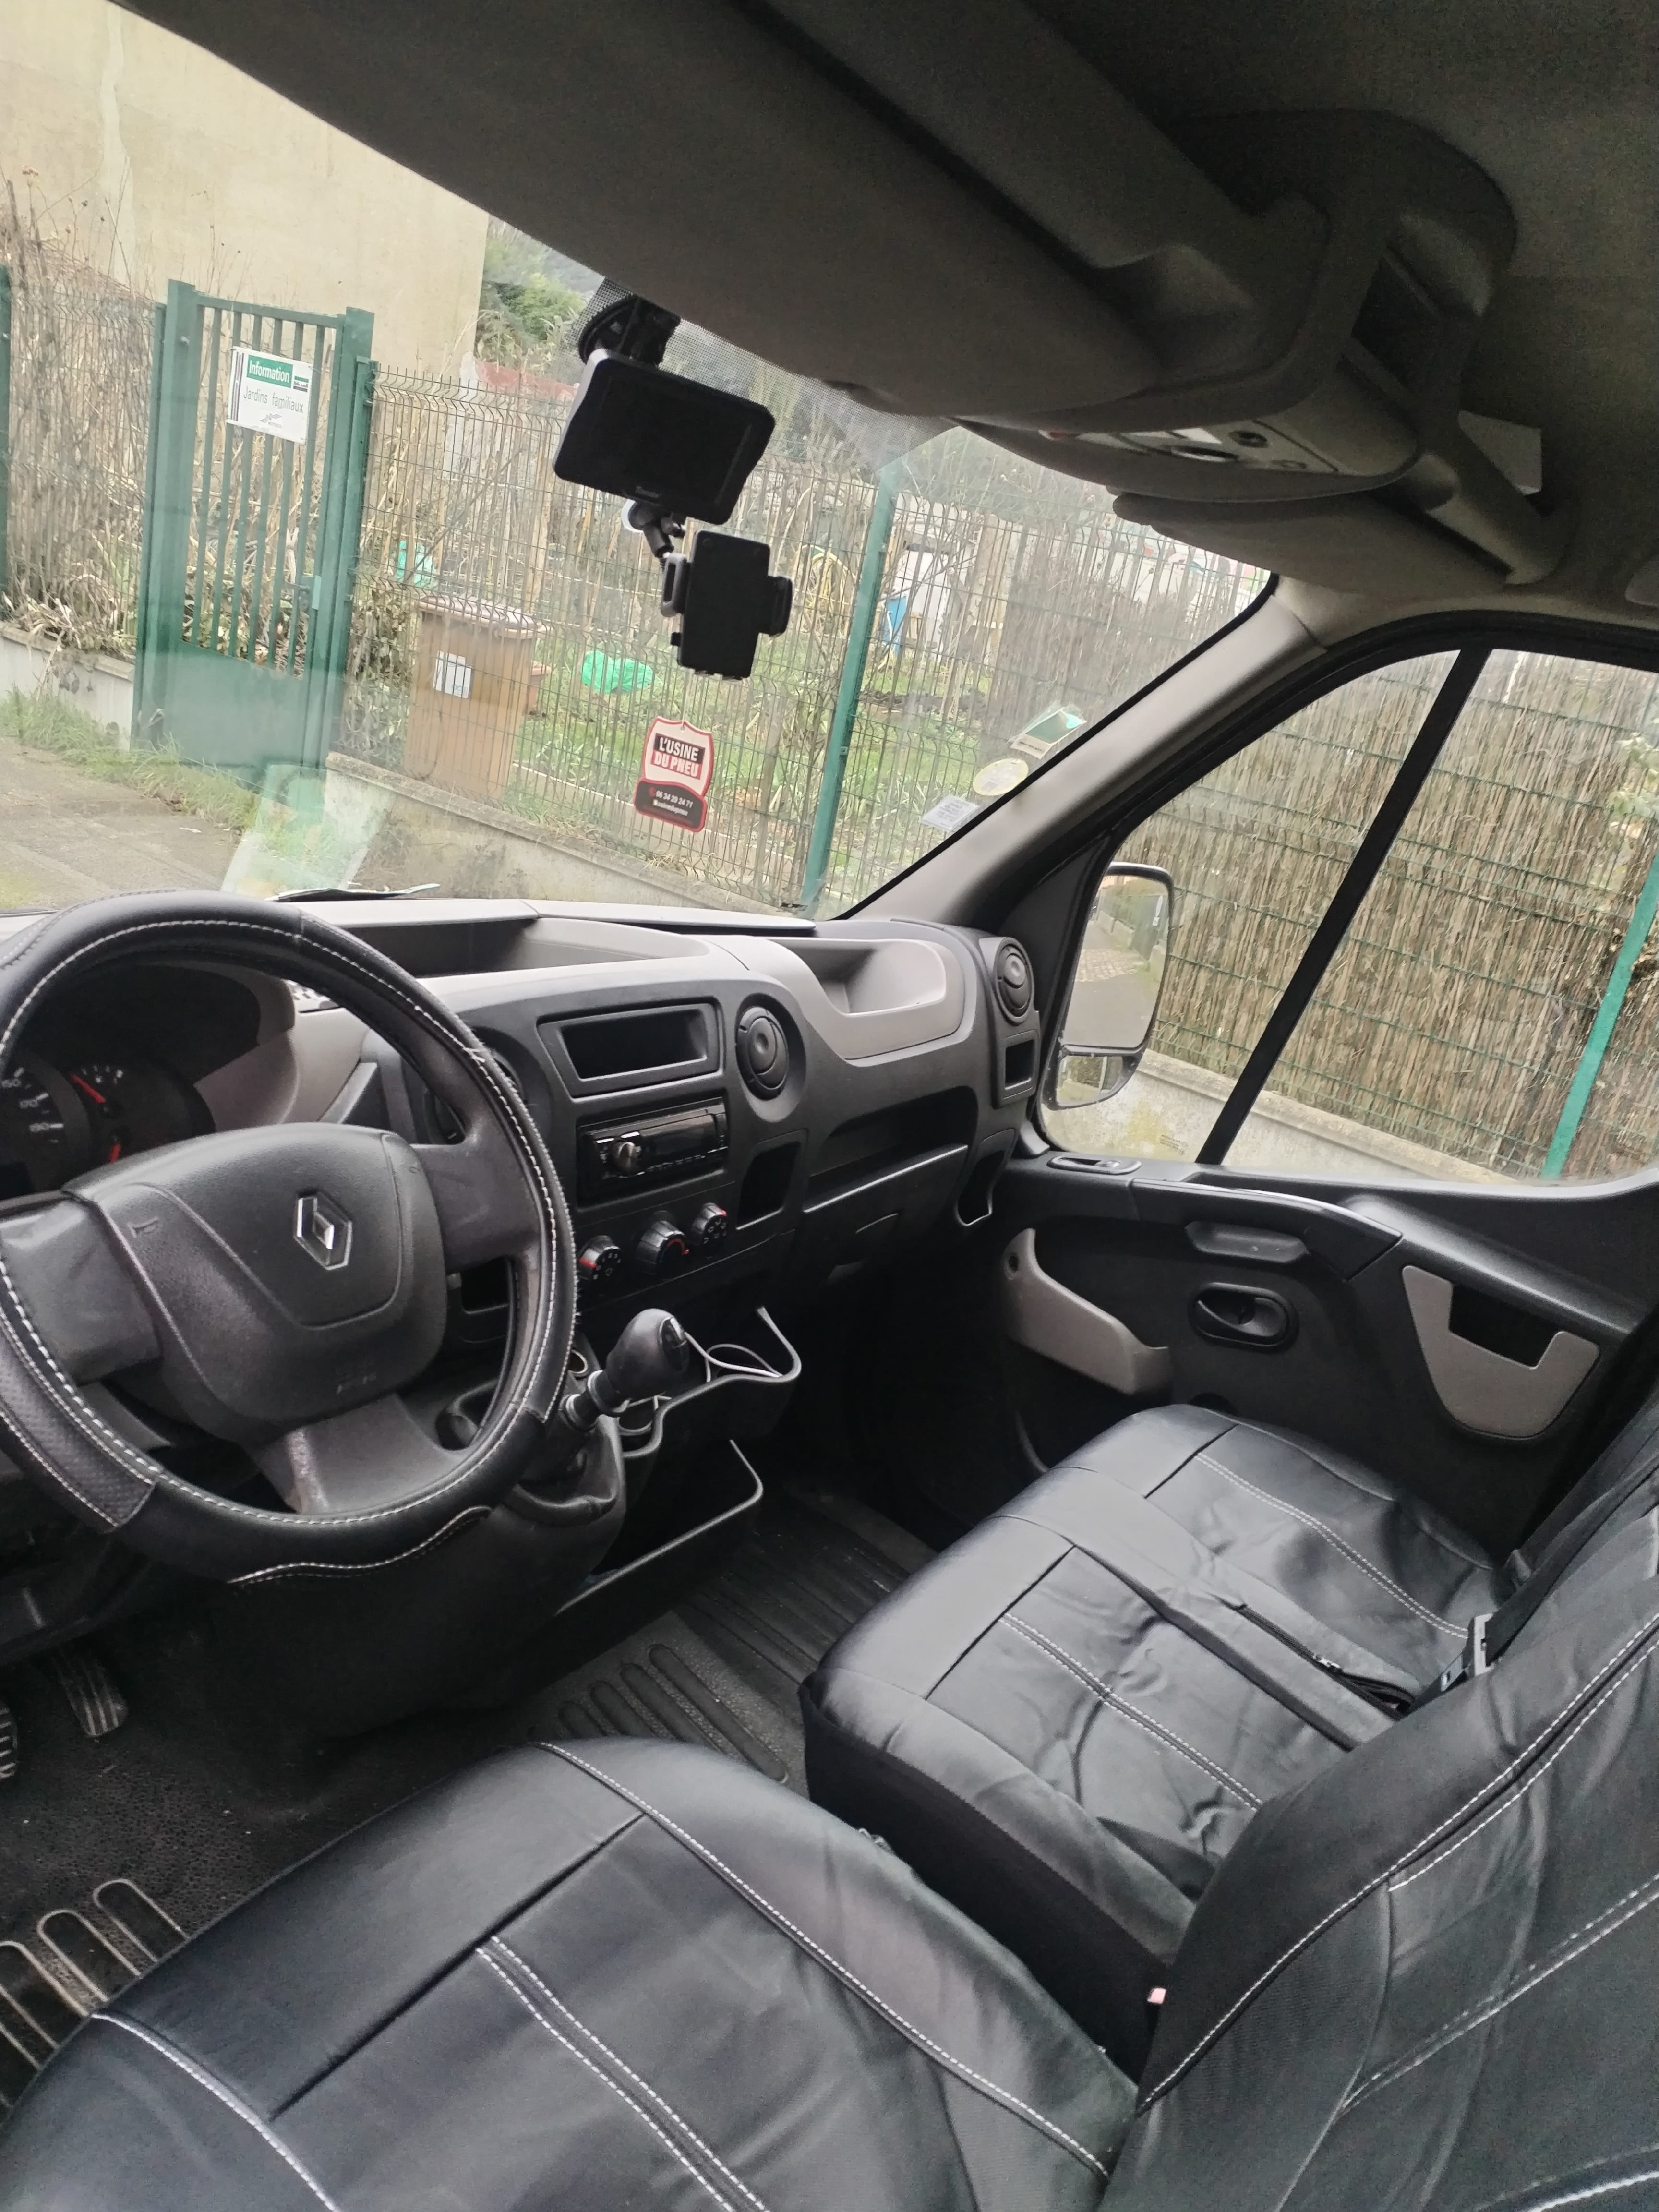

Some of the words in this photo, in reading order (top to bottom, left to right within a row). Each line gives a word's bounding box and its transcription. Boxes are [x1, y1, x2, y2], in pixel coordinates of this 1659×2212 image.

[249, 360, 290, 383] Information
[243, 386, 268, 404] Jardins
[272, 392, 303, 413] familiaux
[659, 737, 699, 762] L'USINE
[654, 751, 670, 768] DU
[670, 756, 699, 777] PNEU
